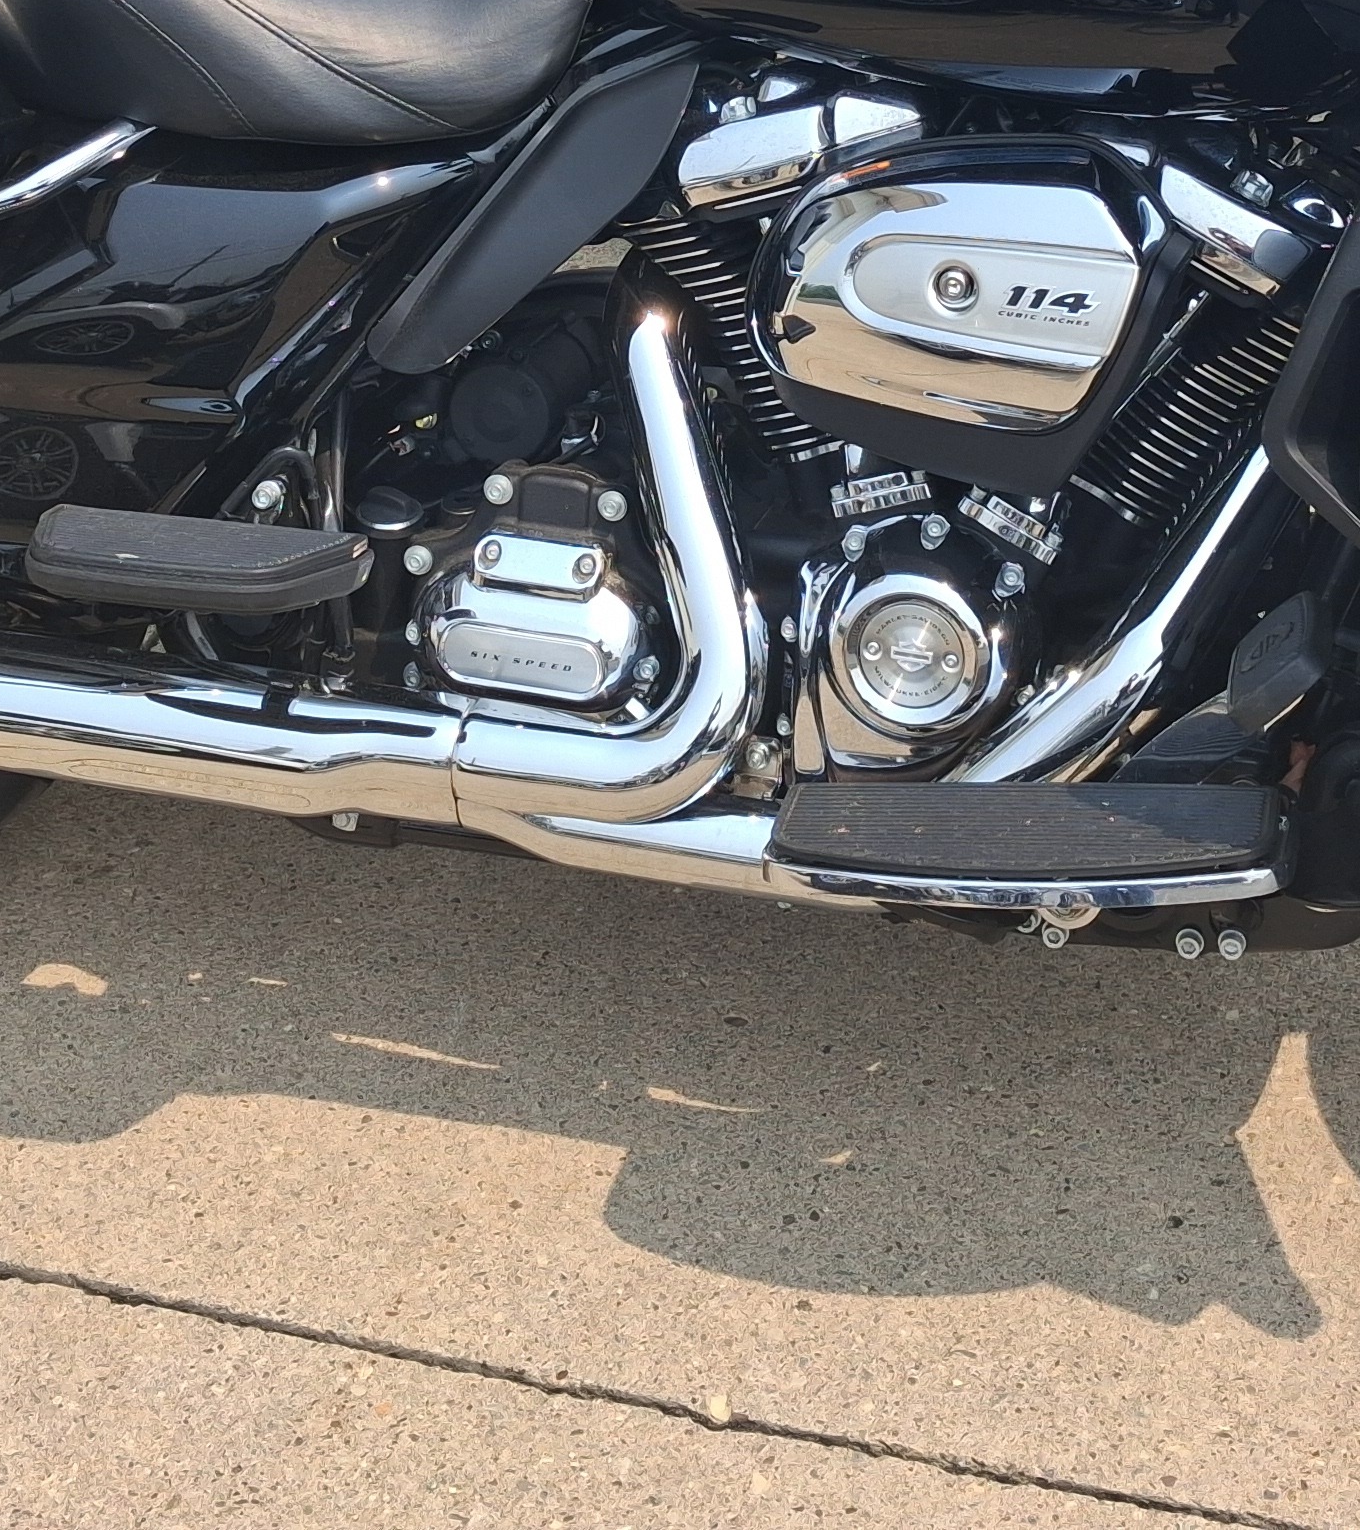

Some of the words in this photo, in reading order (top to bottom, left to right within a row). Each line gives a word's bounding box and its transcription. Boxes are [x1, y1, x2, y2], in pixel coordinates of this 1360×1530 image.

[1002, 283, 1101, 317] 114
[997, 310, 1037, 321] CUBIC
[1043, 315, 1091, 327] INCHES
[470, 650, 501, 662] SIX
[512, 657, 572, 672] SPEED
